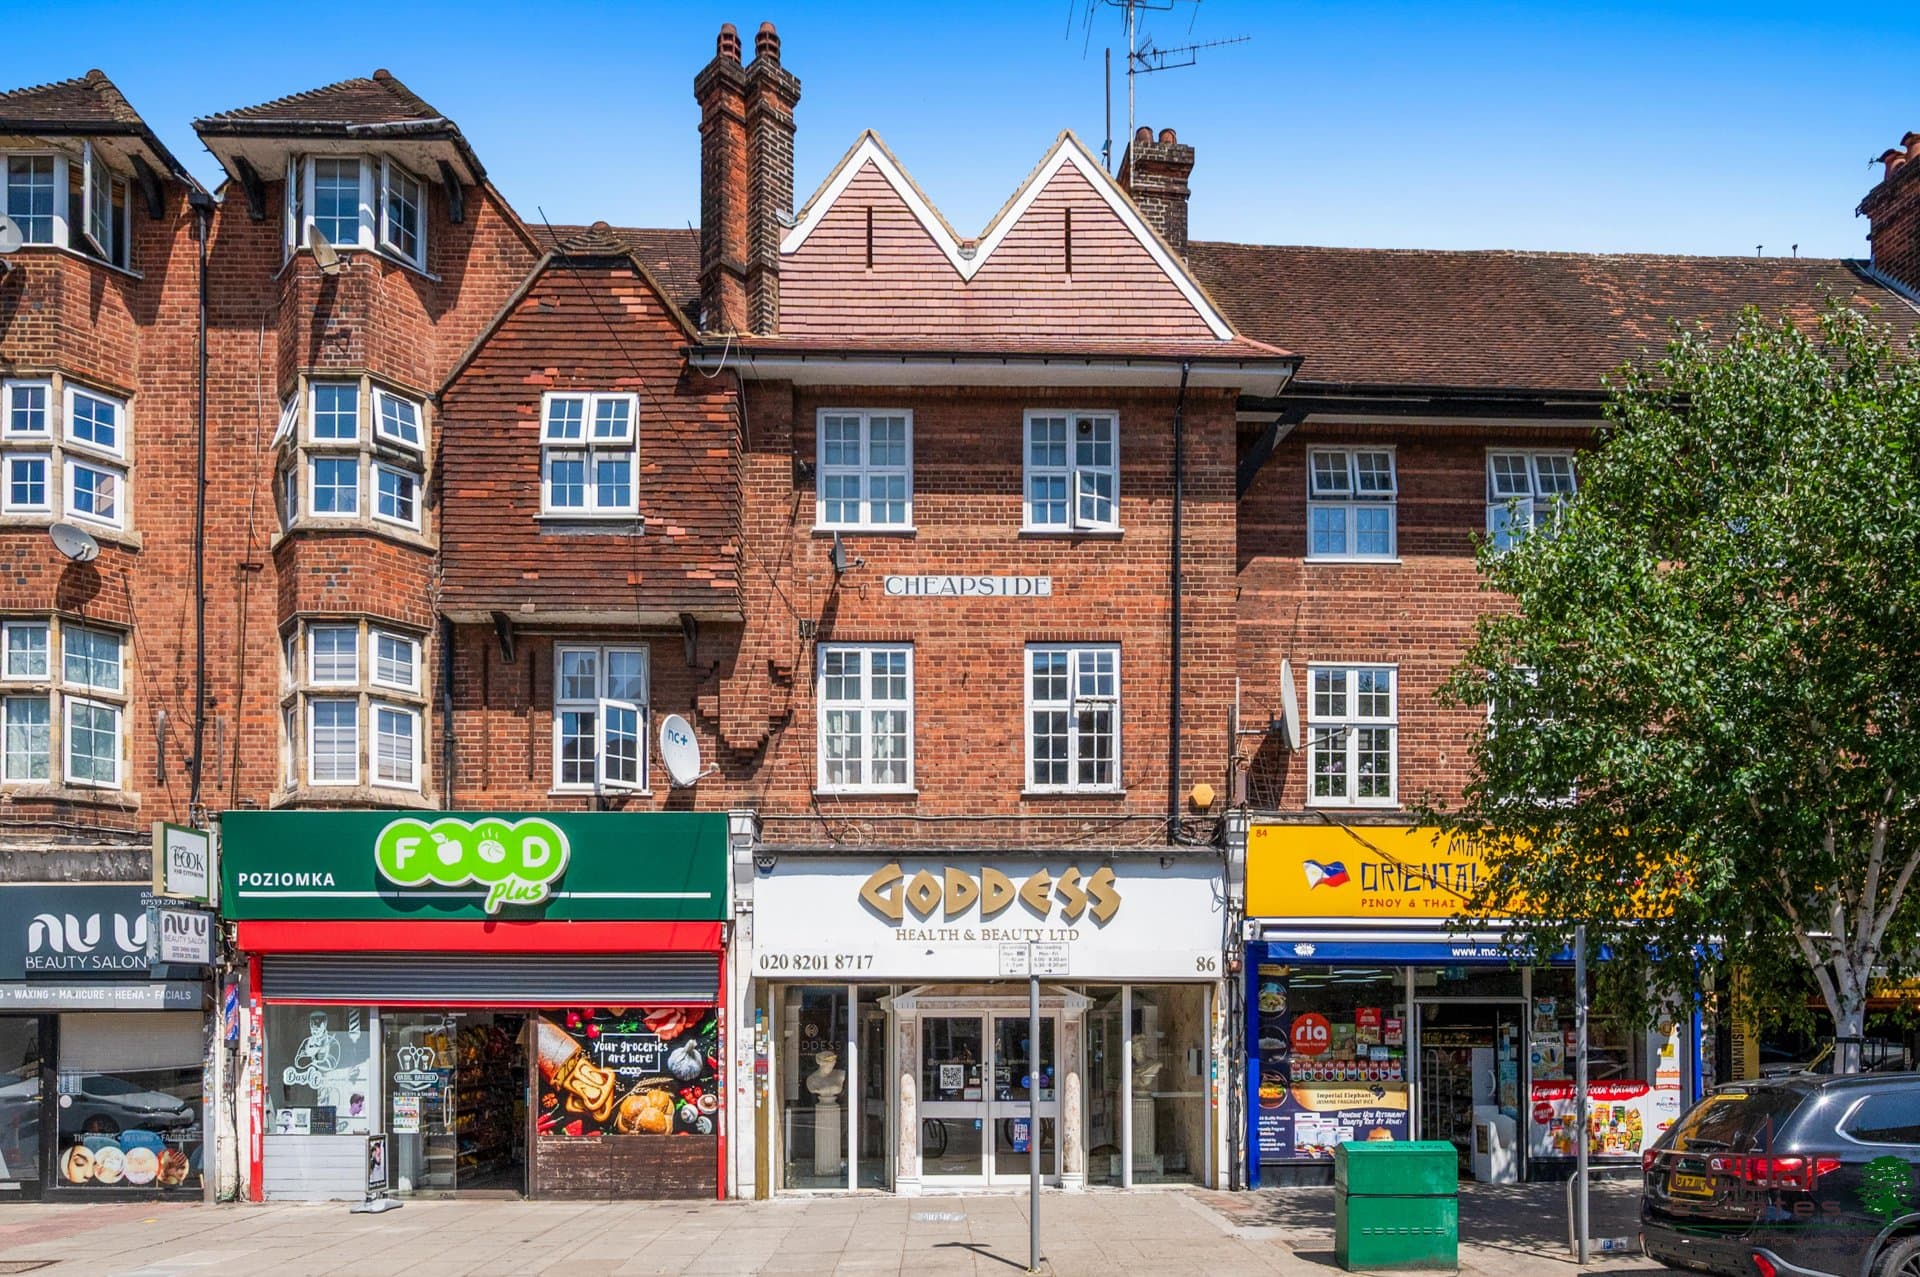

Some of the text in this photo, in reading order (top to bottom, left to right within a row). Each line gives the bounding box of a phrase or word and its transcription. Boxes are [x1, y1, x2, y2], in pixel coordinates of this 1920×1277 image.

[885, 577, 1051, 596] CHEAPSIDE
[1255, 829, 1268, 838] 84
[239, 872, 335, 887] POZIOMKA
[486, 882, 544, 911] plus
[858, 863, 1121, 924] GODDESS
[1361, 899, 1401, 908] PINOY
[1424, 899, 1456, 908] THAI
[895, 929, 1080, 942] HEALTH & BEAUTY LTD
[25, 956, 148, 969] BEAUTY SALON
[759, 954, 873, 971] 020 8201 8717
[1196, 956, 1216, 973] 86
[14, 989, 49, 1000] WAXING
[155, 990, 192, 1000] FACIALS
[1295, 1018, 1327, 1041] ria
[620, 1041, 669, 1053] groceries
[608, 1053, 626, 1063] are
